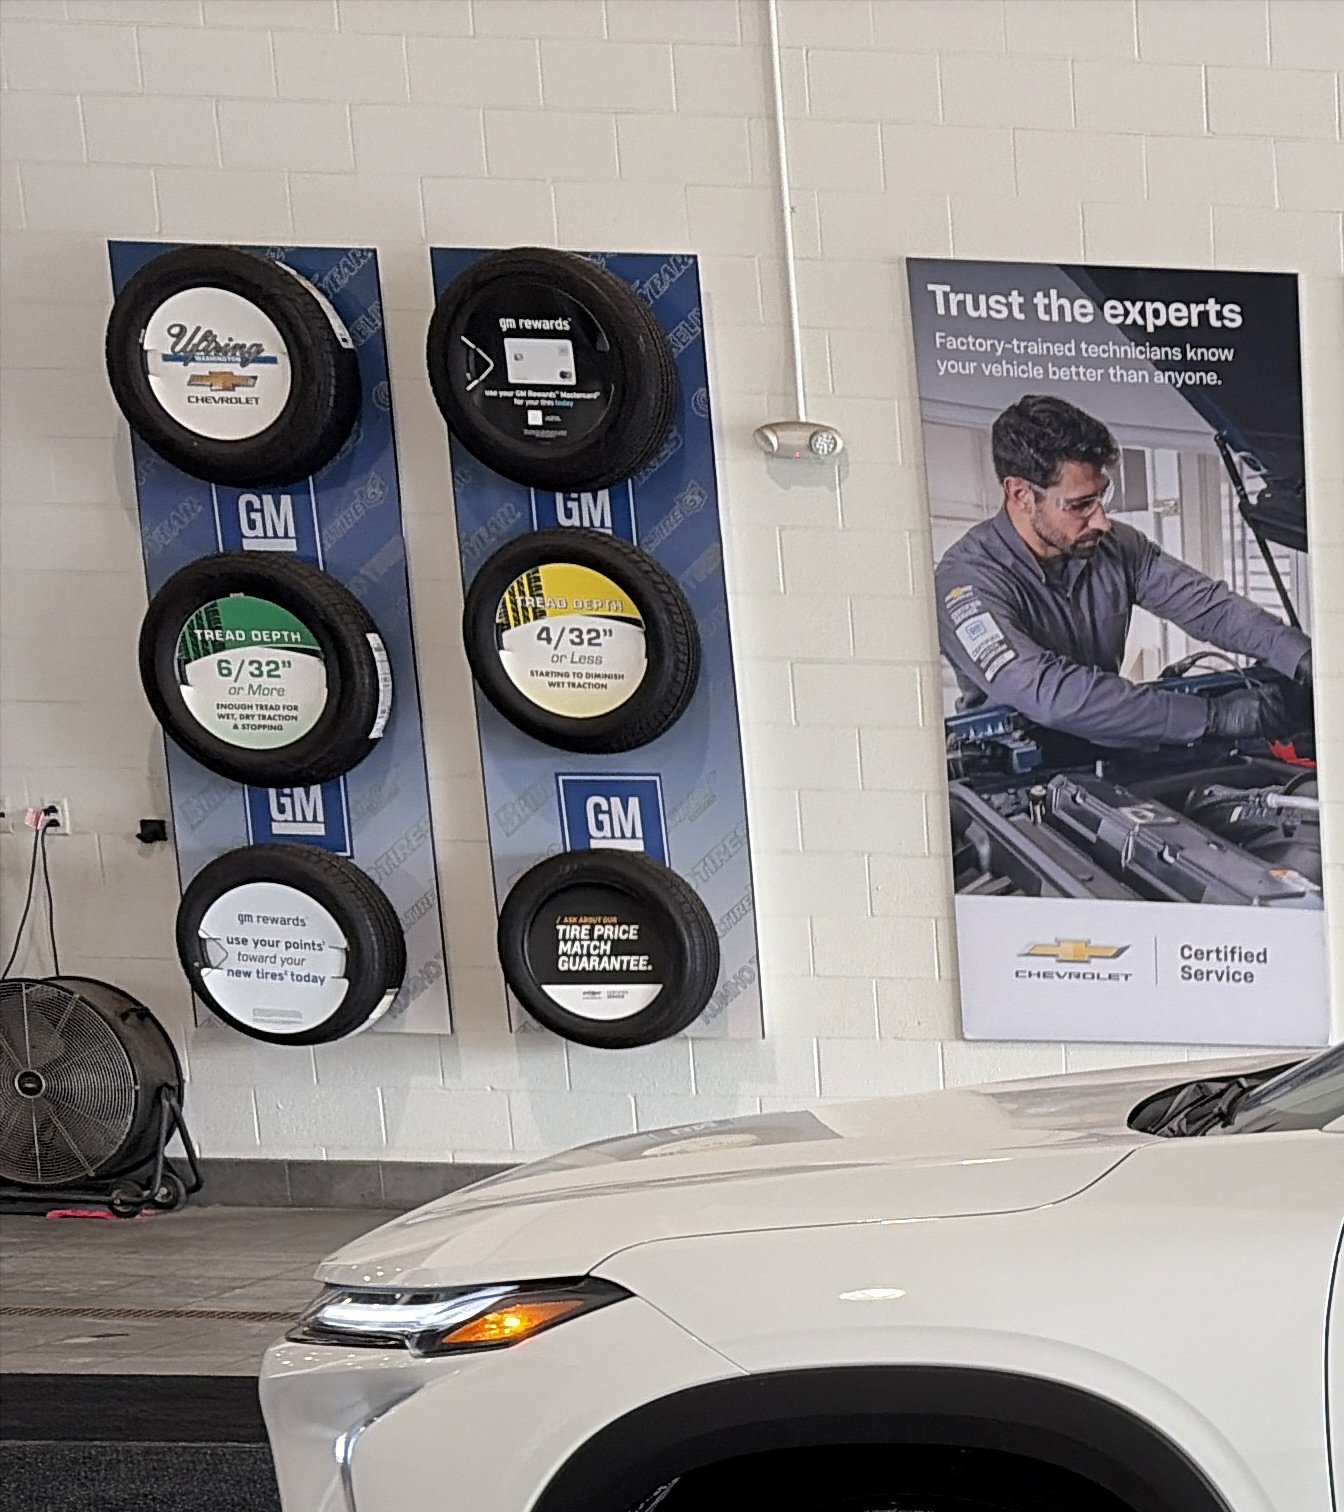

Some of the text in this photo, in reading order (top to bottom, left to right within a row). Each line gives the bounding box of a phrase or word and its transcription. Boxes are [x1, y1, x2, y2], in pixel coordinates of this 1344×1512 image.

[927, 283, 1243, 332] Trust the experts
[935, 332, 1234, 362] Factory-trained technicians know
[937, 359, 1223, 387] your vehicle better than anyone.
[188, 396, 260, 405] CHEVROLET
[238, 494, 296, 538] GM
[556, 490, 612, 528] GM
[517, 596, 623, 611] TREAD DEPTH
[194, 629, 301, 643] TREAD DEPTH
[551, 652, 603, 665] or Less
[530, 670, 569, 679] STARTING
[585, 672, 624, 680] DIMINISH
[228, 684, 285, 696] or More
[548, 681, 607, 690] WET TRACTION
[216, 703, 299, 712] ENOUGH TREAD FOR
[239, 713, 256, 722] DRY
[257, 713, 298, 722] TRACTION
[233, 723, 283, 732] & STOPPING
[268, 786, 325, 822] GM
[586, 795, 643, 839] GM
[238, 913, 252, 925] gm
[556, 924, 639, 940] TIRE PRICE
[227, 936, 280, 950] use your
[558, 940, 611, 956] MATCH
[237, 950, 306, 968] toward your
[1180, 944, 1267, 964] Certified
[558, 955, 652, 971] GUARANTEE.
[227, 968, 326, 986] new today
[1015, 970, 1132, 981] CHEVROLET
[1181, 964, 1254, 984] Service
